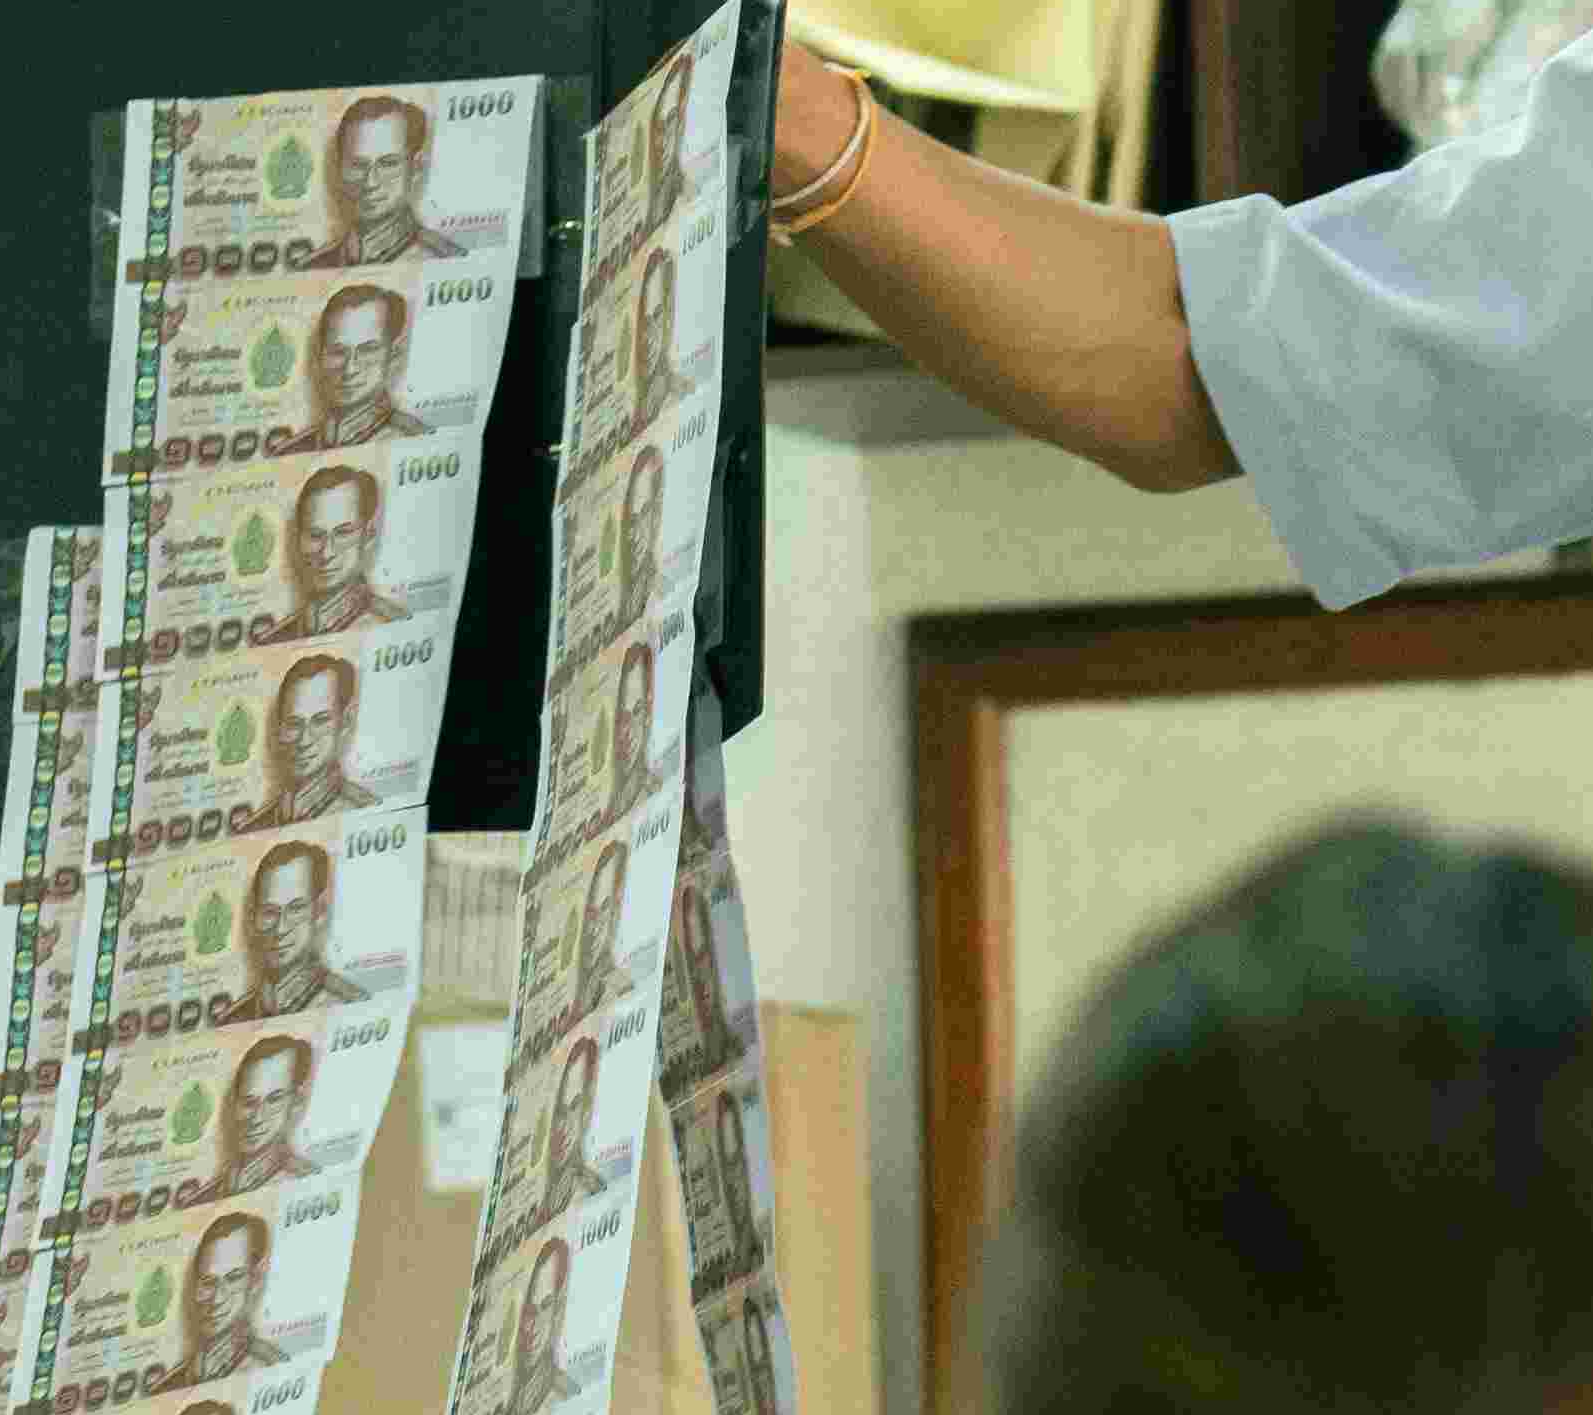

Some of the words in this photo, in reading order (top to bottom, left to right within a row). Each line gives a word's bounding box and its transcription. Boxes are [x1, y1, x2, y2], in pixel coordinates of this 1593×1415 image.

[447, 91, 514, 121] 1000
[680, 214, 713, 256] 1000
[425, 278, 494, 309] 1000
[671, 410, 706, 454] 1000
[397, 453, 460, 485] 1000
[373, 639, 434, 672] 1000
[344, 825, 406, 858] 1000
[635, 809, 670, 848] 1000
[327, 1020, 390, 1053] 1000
[607, 1007, 647, 1048] 1000
[283, 1193, 341, 1229] 1000
[580, 1209, 621, 1250] 1000
[251, 1378, 305, 1414] 1000
